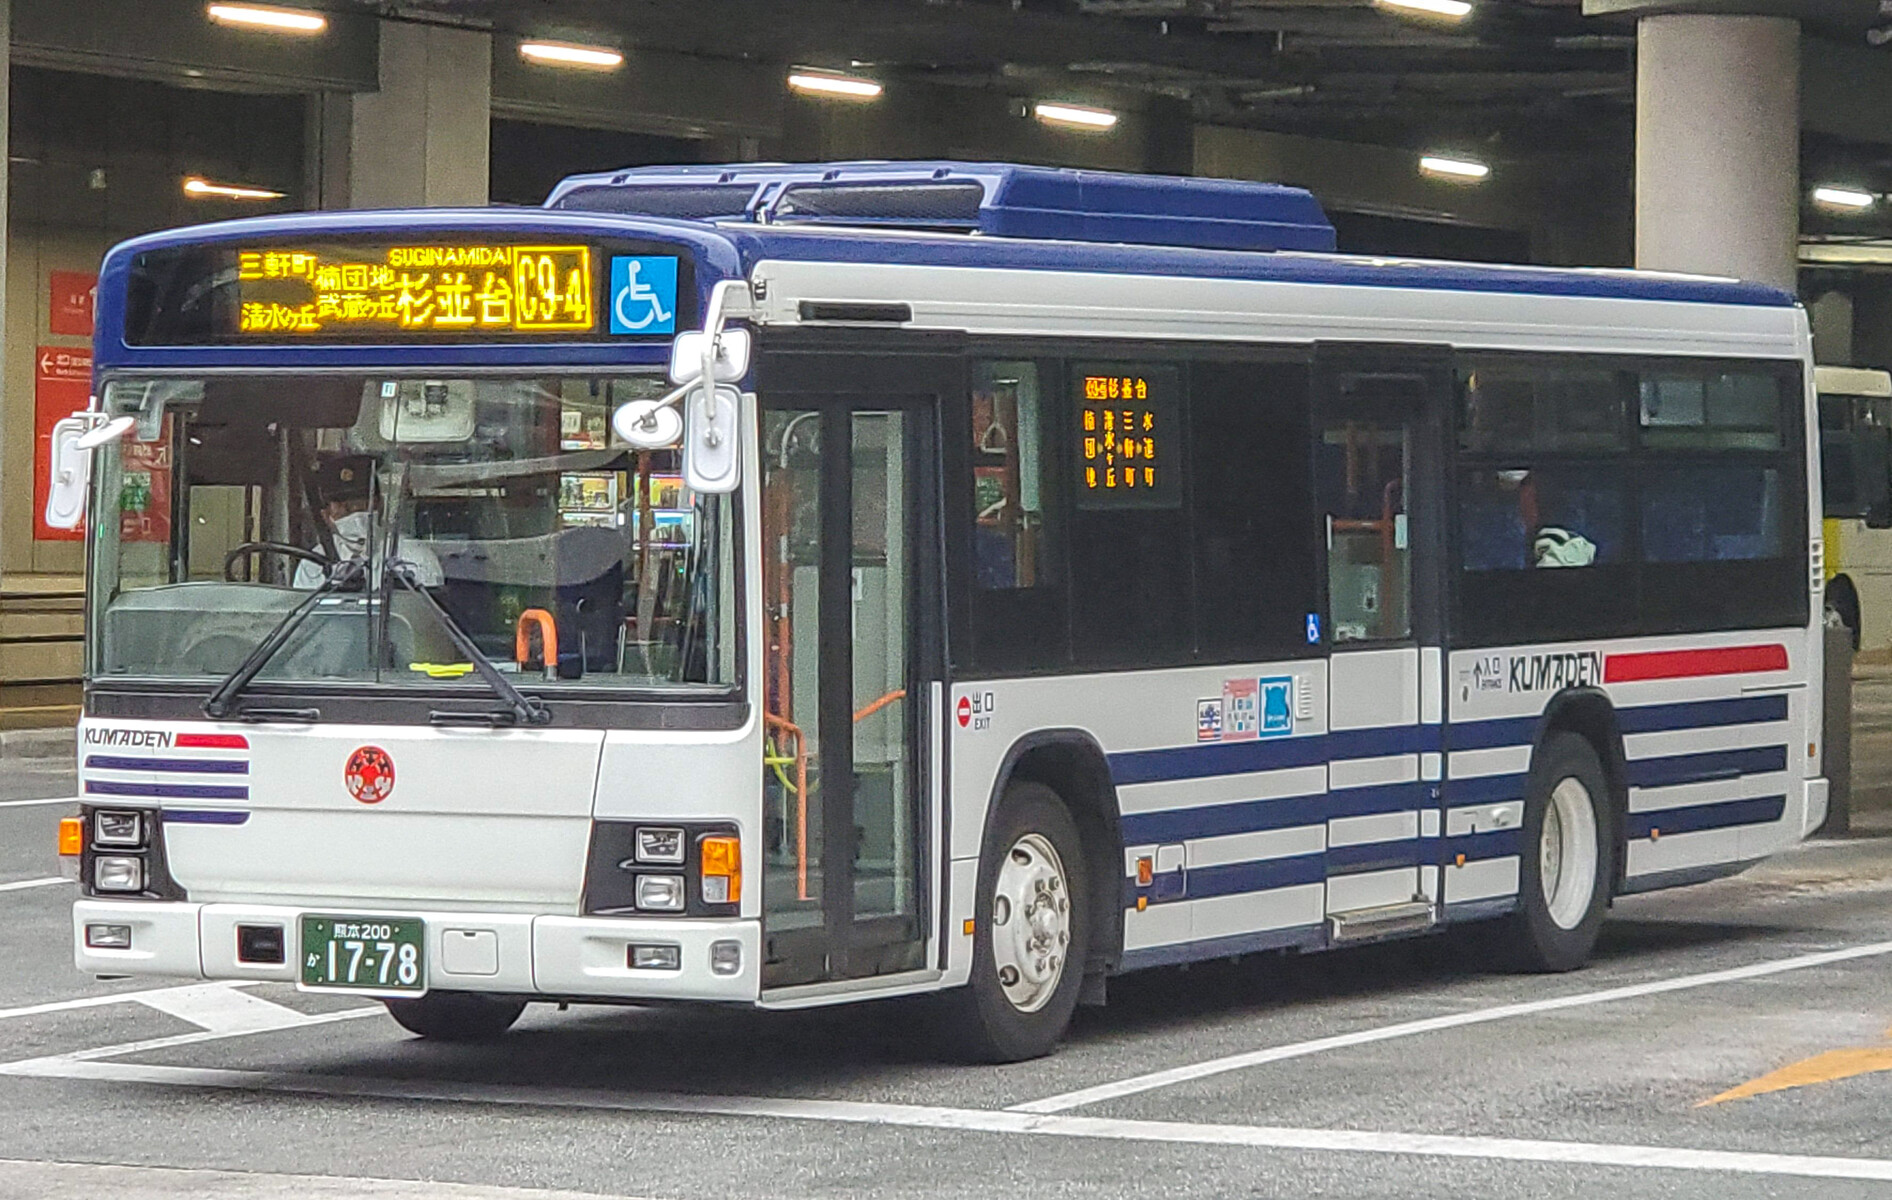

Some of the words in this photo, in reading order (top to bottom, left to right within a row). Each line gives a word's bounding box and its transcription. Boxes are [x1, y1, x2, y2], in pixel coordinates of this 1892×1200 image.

[239, 252, 316, 280] 三軒町
[390, 247, 511, 266] SUGINAMIDAI
[396, 271, 513, 324] 杉並台
[519, 255, 586, 321] C9-4
[1508, 650, 1603, 693] KUMADEN
[972, 691, 994, 714] 出口
[84, 727, 172, 748] KUMADEN
[974, 717, 991, 731] EXIT
[306, 952, 321, 968] か
[328, 940, 418, 985] 17-78
